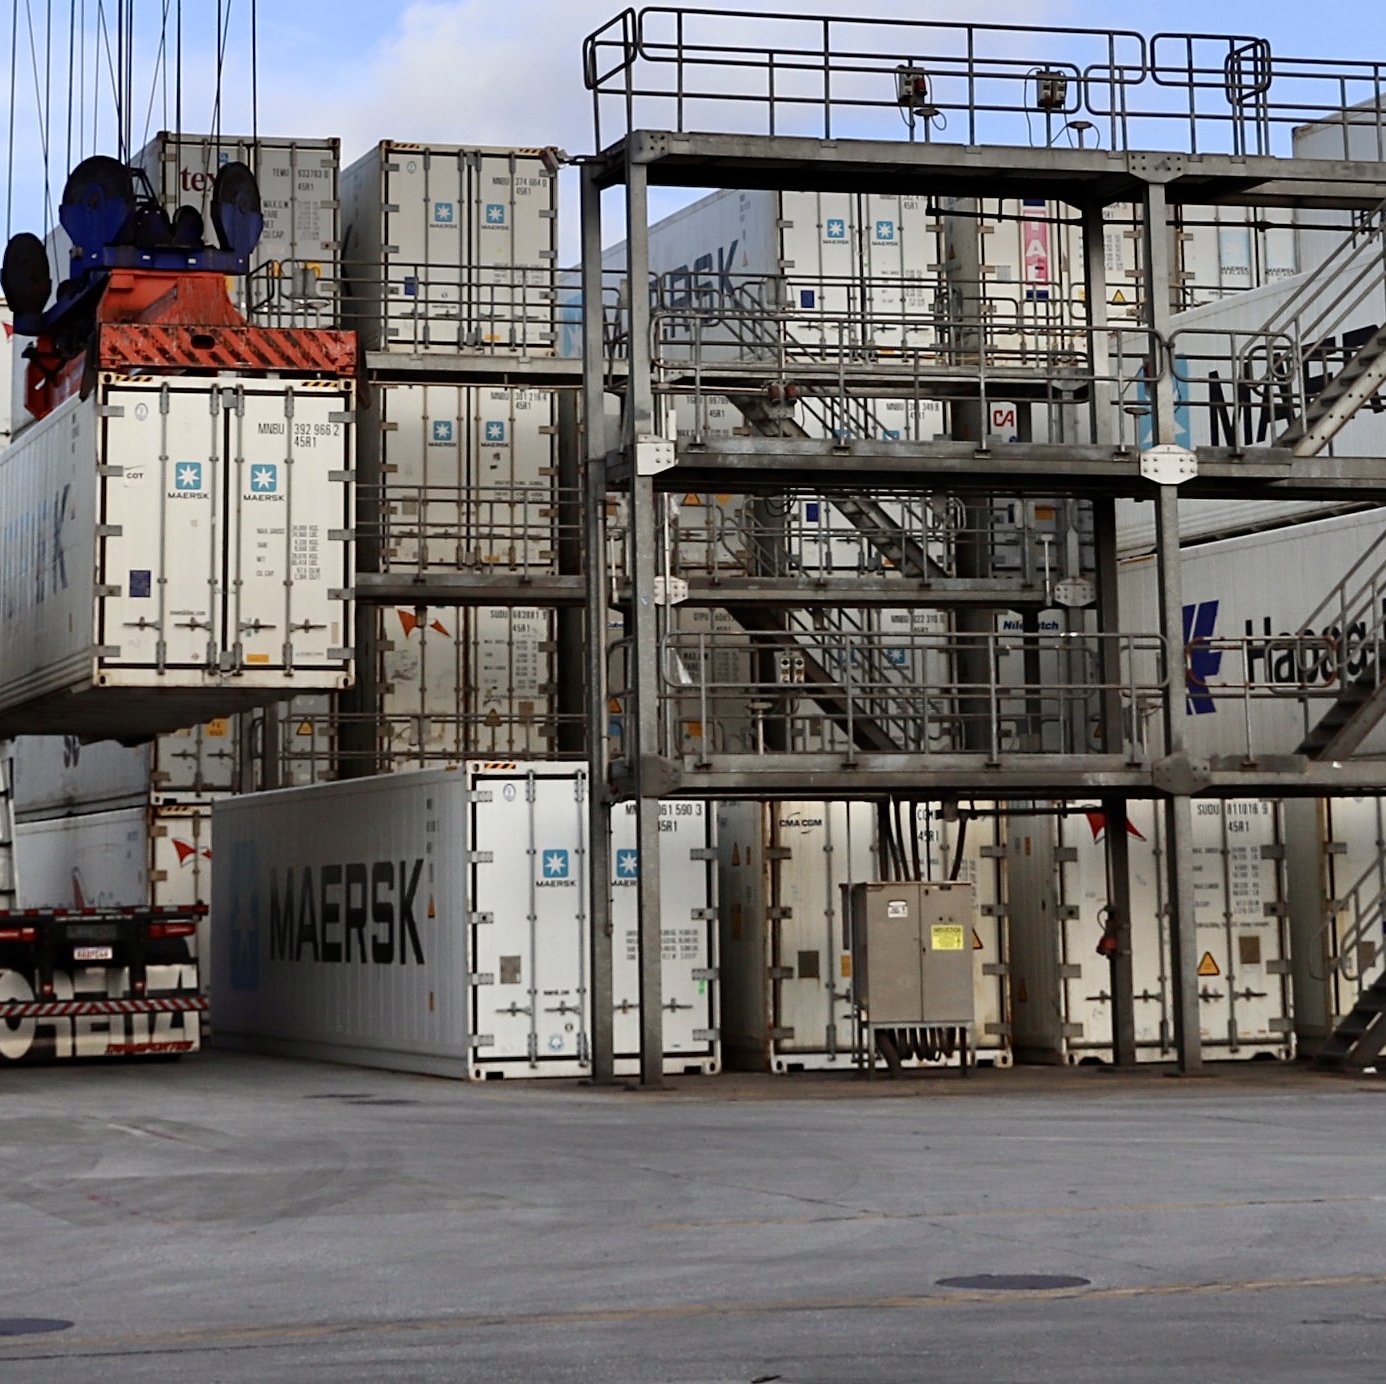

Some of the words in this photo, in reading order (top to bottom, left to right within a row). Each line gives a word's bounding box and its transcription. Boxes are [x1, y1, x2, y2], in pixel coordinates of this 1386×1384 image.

[257, 422, 286, 436] MNBU
[294, 423, 311, 436] 392
[314, 424, 331, 436] 966
[333, 425, 340, 437] 2
[294, 436, 317, 448] 45R1
[167, 491, 211, 500] MAERSK
[243, 493, 287, 502] MAERSK
[675, 804, 693, 816] 590
[696, 805, 703, 817] 3
[1196, 803, 1221, 816] SUDU
[779, 819, 800, 827] CMA
[801, 819, 823, 827] CGM
[1228, 820, 1250, 833] 45R1
[535, 880, 577, 888] MAERSK
[269, 858, 425, 965] MAERSK
